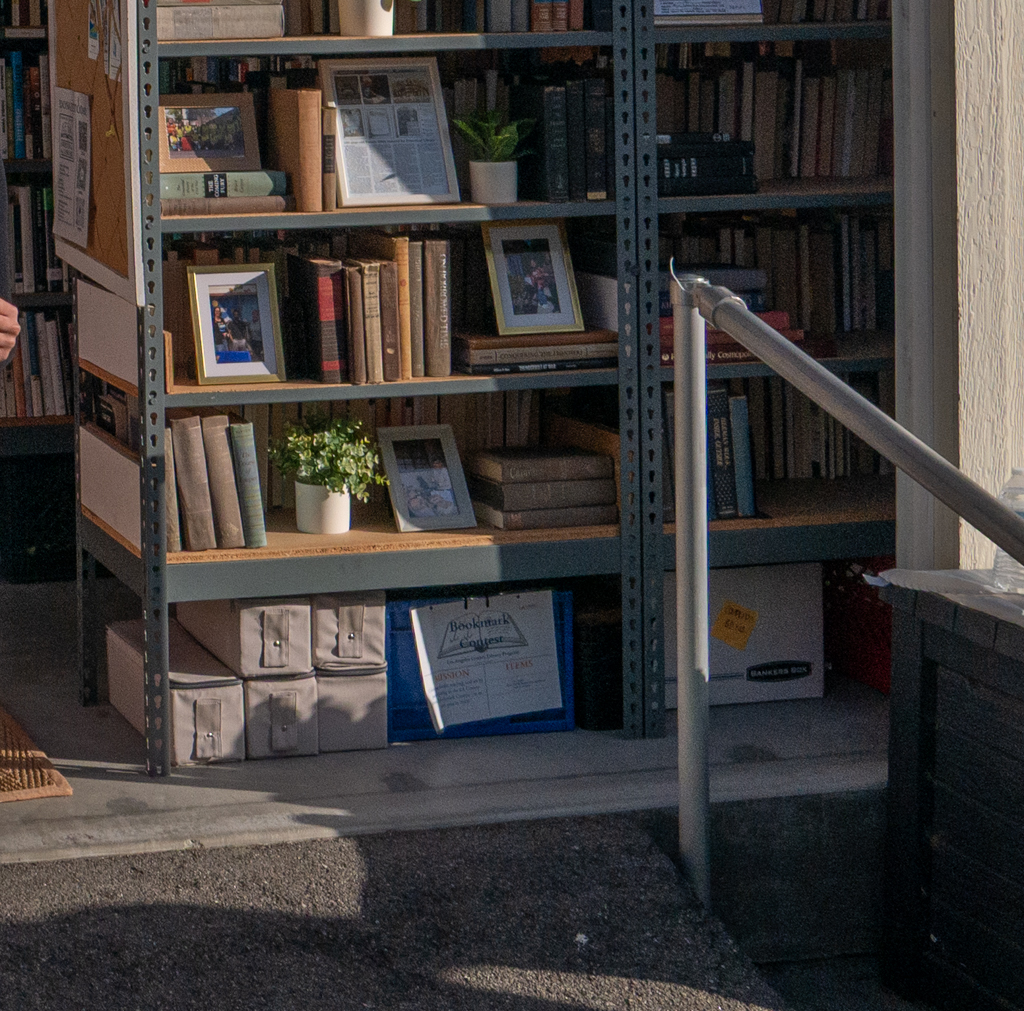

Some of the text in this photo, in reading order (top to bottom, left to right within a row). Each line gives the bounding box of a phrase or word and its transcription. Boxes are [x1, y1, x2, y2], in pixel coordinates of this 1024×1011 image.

[449, 613, 510, 633] Bookmark
[459, 635, 504, 648] Contest
[750, 668, 789, 677] BANKERS
